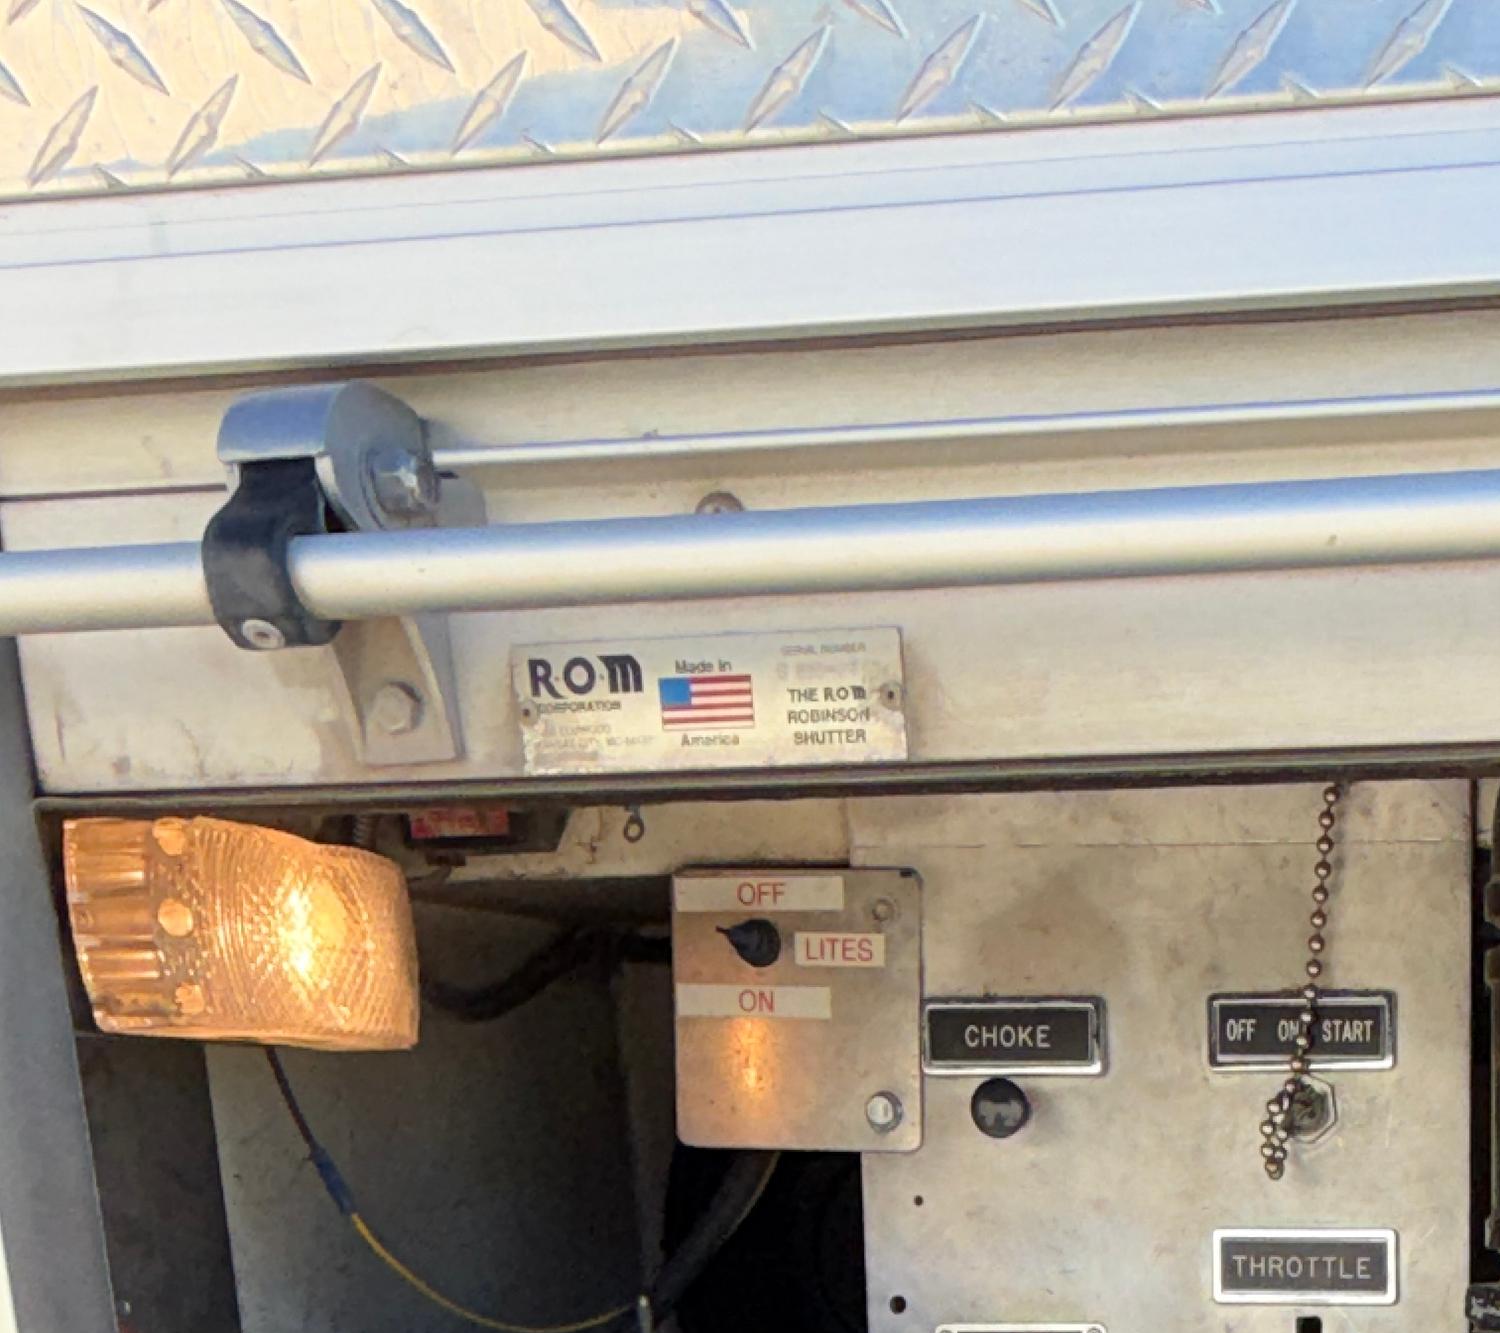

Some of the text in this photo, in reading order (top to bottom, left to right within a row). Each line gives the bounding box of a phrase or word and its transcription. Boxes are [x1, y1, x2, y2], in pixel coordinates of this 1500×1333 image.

[675, 659, 714, 674] Made
[787, 687, 819, 703] THE
[786, 706, 871, 724] ROBINSON
[681, 733, 740, 747] America
[793, 728, 867, 745] SHUTTER
[737, 882, 786, 906] OFF
[805, 938, 873, 962] LITES
[738, 989, 775, 1012] ON
[964, 1024, 1051, 1049] CHOKE
[1226, 1018, 1375, 1043] OFF ON START
[1232, 1255, 1371, 1280] THROTTLE
